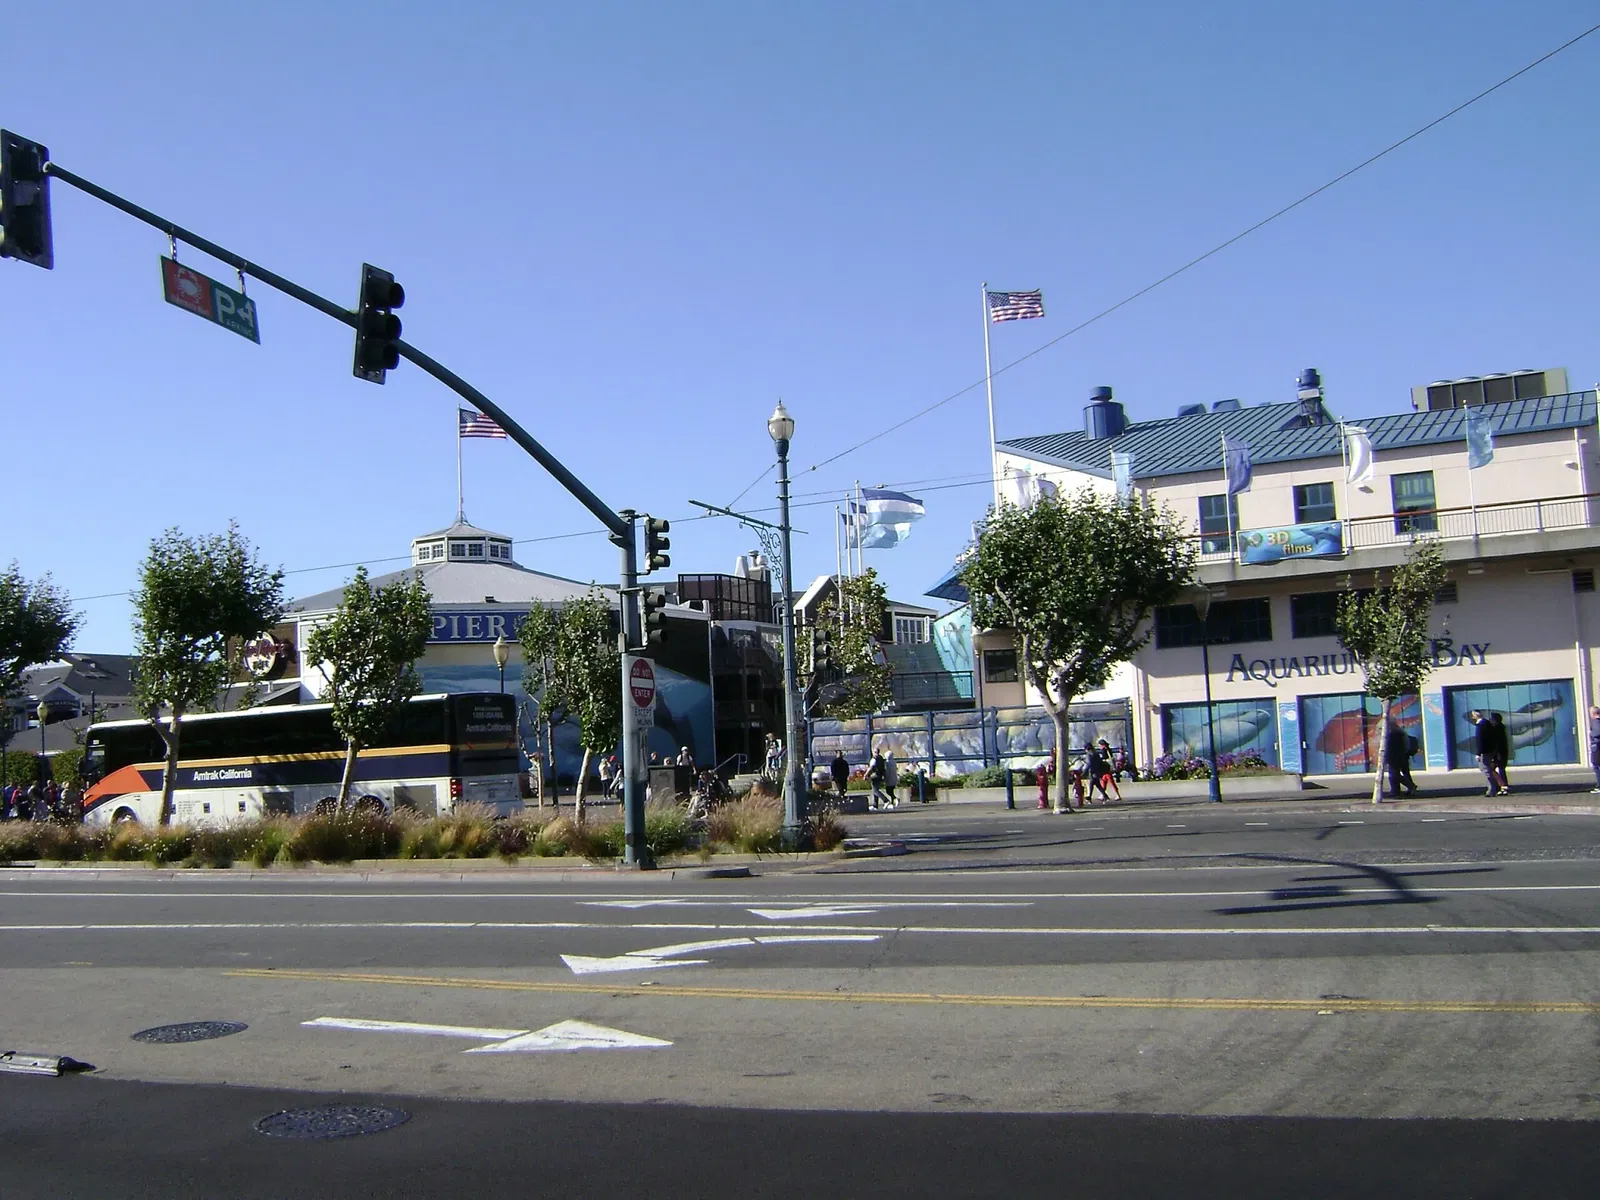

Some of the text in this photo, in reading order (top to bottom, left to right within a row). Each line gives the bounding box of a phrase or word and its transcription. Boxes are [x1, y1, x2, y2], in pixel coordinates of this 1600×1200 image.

[1266, 531, 1290, 546] 3D
[1282, 544, 1312, 554] films
[430, 615, 509, 639] PIER
[1428, 638, 1491, 668] BAY
[634, 688, 651, 698] ENTER
[193, 768, 252, 781] Amtrak California
